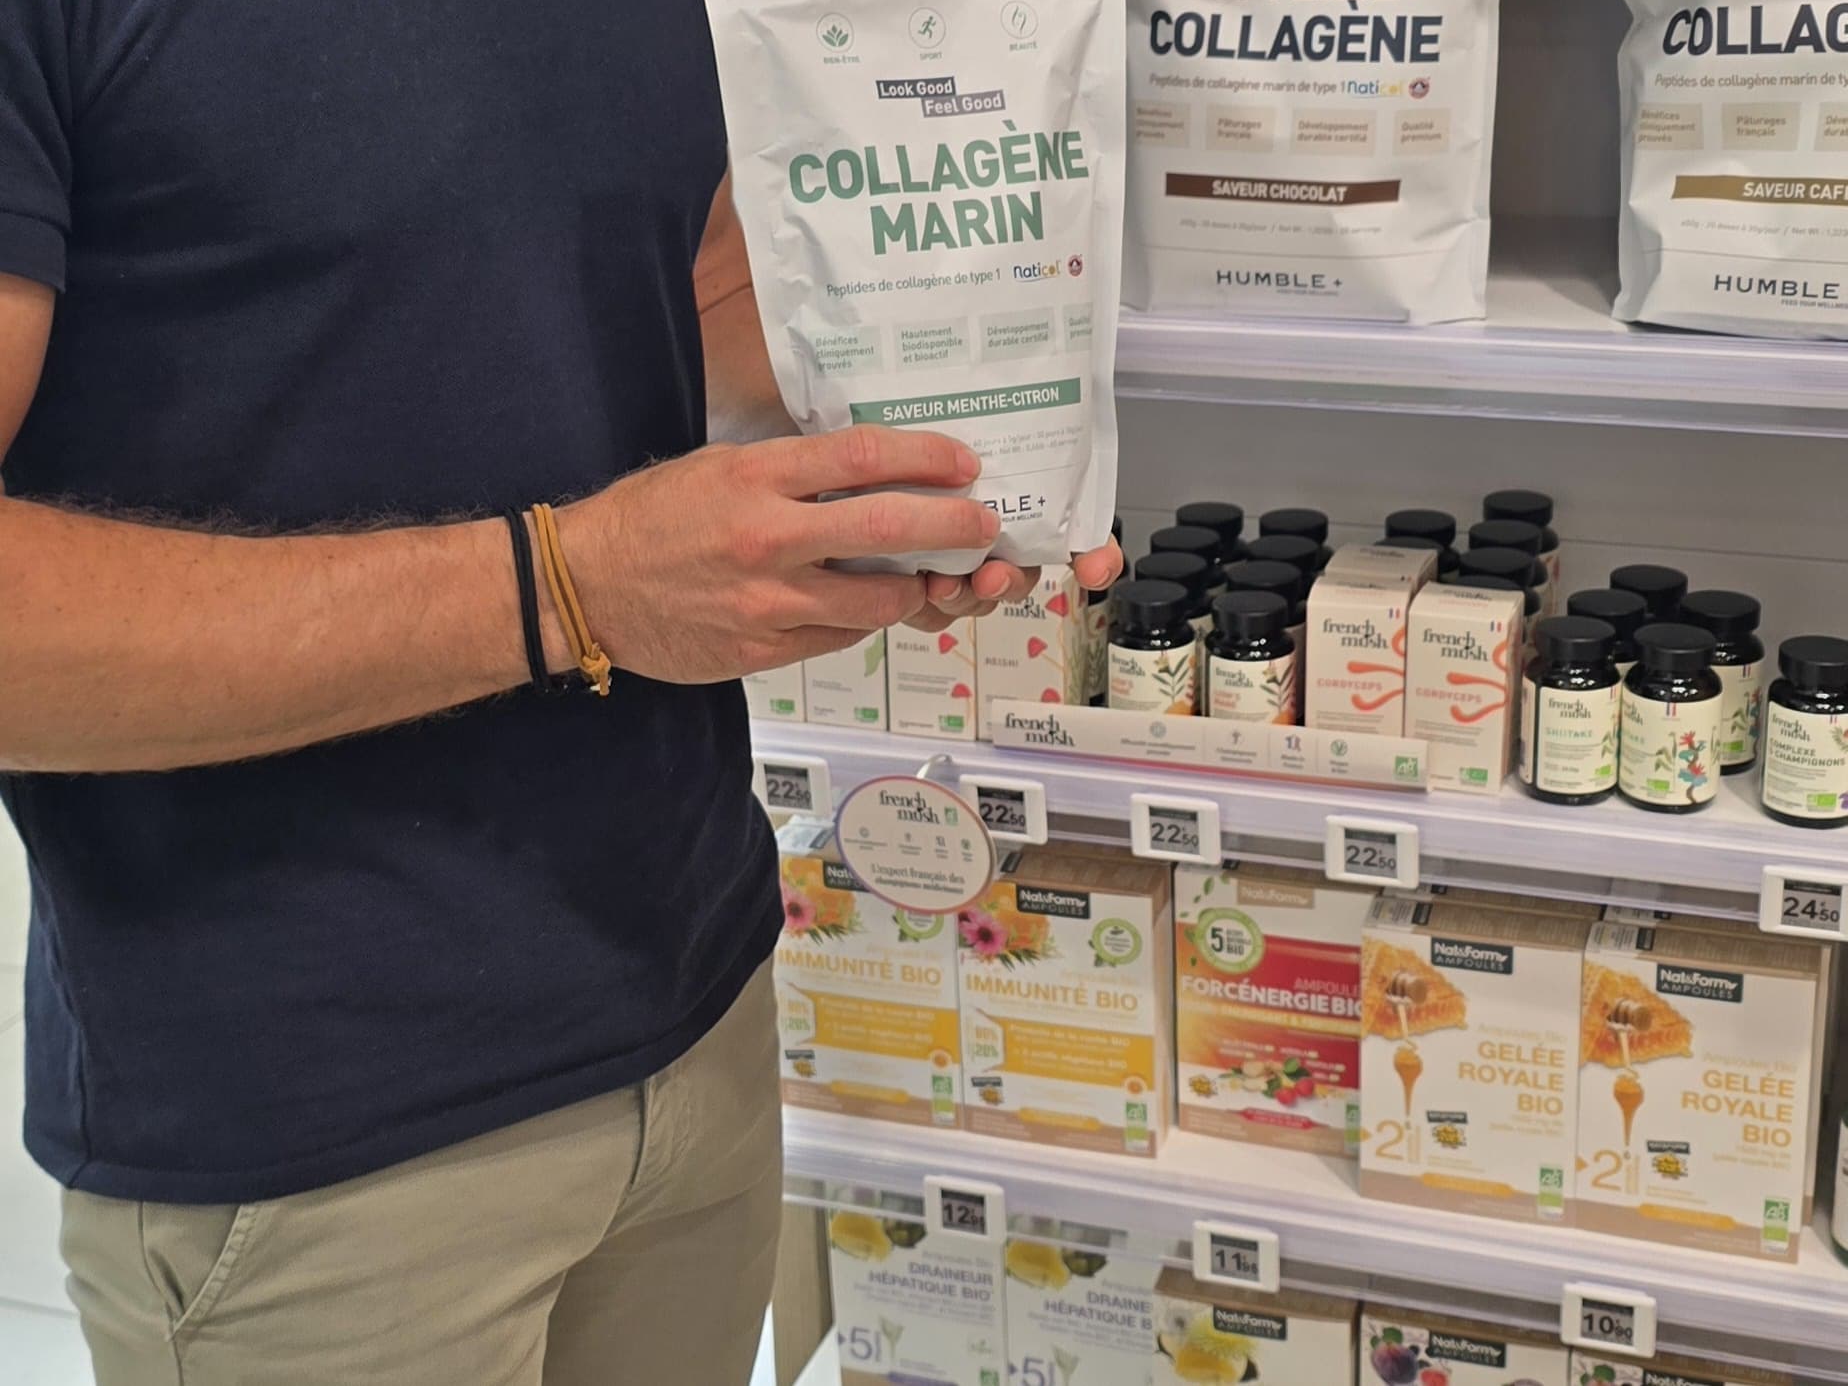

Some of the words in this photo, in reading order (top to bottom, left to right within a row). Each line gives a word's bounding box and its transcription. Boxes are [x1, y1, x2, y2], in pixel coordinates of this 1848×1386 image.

[919, 51, 943, 61] SPORT
[1009, 41, 1038, 51] BEAUTÉ
[879, 81, 914, 97] Look
[916, 80, 953, 95] Good
[1150, 74, 1190, 88] Peptides
[1193, 76, 1205, 86] de
[1207, 76, 1260, 93] collagène
[1263, 80, 1295, 92] marin
[1298, 80, 1310, 92] de
[1313, 81, 1337, 96] type
[1655, 73, 1698, 88] Peptides
[1701, 75, 1715, 86] de
[1718, 73, 1777, 89] collagène
[1780, 73, 1817, 86] marin
[1820, 73, 1836, 85] de
[925, 100, 959, 114] Feel
[962, 95, 1002, 111] Good
[1736, 115, 1786, 126] Pâturages
[1736, 126, 1776, 137] français
[788, 119, 1089, 204] COLLAGÈNE
[1212, 180, 1268, 199] SAVEUR
[1269, 184, 1348, 203] CHOCOLAT
[1743, 182, 1805, 198] SAVEUR
[870, 191, 1044, 255] MARIN
[827, 281, 876, 297] Peptides
[878, 279, 893, 291] de
[896, 272, 952, 290] collagène
[954, 273, 968, 284] de
[970, 271, 993, 284] type
[996, 269, 1000, 280] 1
[1714, 274, 1840, 299] HUMBLE
[901, 327, 952, 340] Hautement
[987, 322, 1049, 336] Développement
[816, 335, 858, 348] Bénéfices
[902, 337, 963, 352] biodisponible
[988, 336, 1018, 348] durable
[816, 346, 874, 360] cliniquement
[915, 350, 949, 362] bioactif
[883, 403, 944, 422] SAVEUR
[947, 387, 1060, 415] MENTHE-CITRON
[1323, 619, 1375, 635] french
[1423, 628, 1476, 647] french
[1005, 713, 1060, 733] french
[879, 790, 927, 809] french
[1211, 927, 1224, 953] 5
[777, 948, 894, 980] IMMUNITÉ
[901, 965, 941, 986] BIO
[1435, 956, 1505, 972] AMPOULES
[965, 973, 1088, 1005] IMMUNITÉ
[1096, 990, 1139, 1011] BIO
[1181, 974, 1330, 1013] FORCÉNERGIE
[1661, 982, 1734, 1001] AMPOULES
[1478, 1039, 1566, 1069] GELÉE
[1458, 1062, 1565, 1092] ROYALE
[1702, 1070, 1796, 1099] GELÉE
[1517, 1094, 1564, 1115] BIO
[1681, 1091, 1793, 1123] ROYALE
[1375, 1119, 1404, 1161] 2
[1742, 1125, 1792, 1147] BIO
[1591, 1150, 1622, 1192] 2
[869, 1269, 959, 1299] HÉPATIQUE
[962, 1286, 991, 1301] BIO
[907, 1262, 993, 1287] DRAINEUR
[1044, 1299, 1136, 1329] HÉPATIQUE
[849, 1327, 873, 1360] 5
